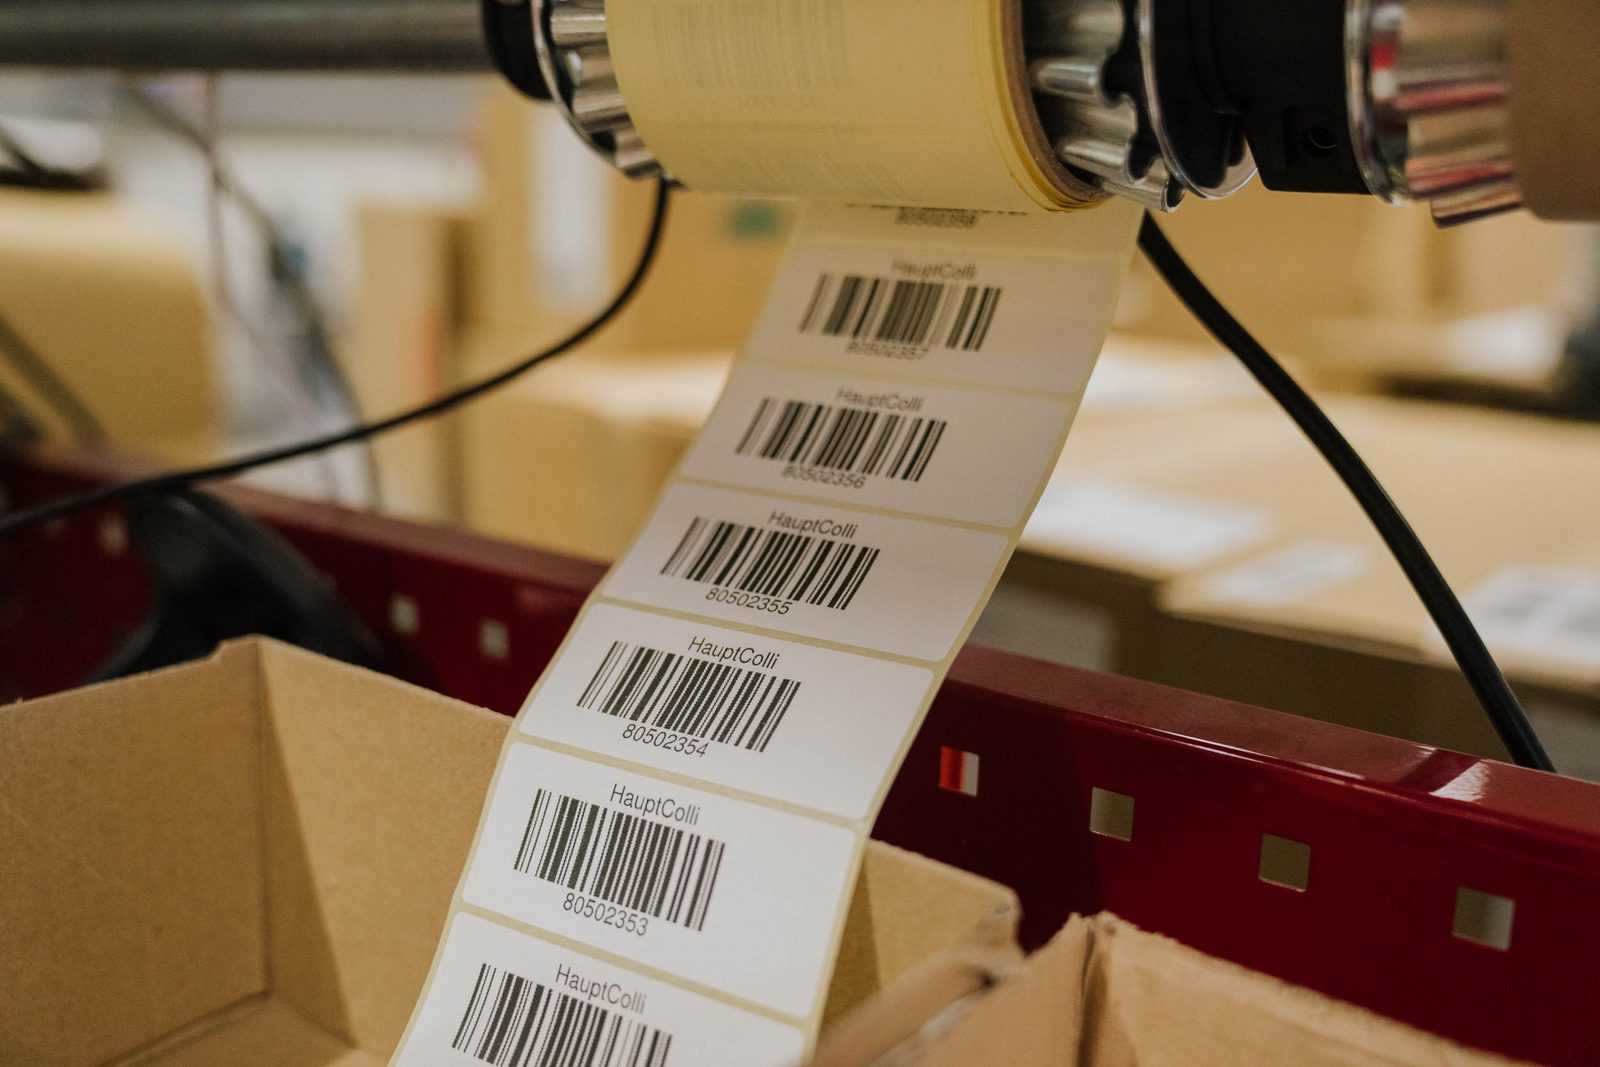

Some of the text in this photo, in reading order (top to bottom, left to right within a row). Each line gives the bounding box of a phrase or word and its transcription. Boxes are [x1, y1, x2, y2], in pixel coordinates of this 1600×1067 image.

[836, 387, 924, 412] HauptColli
[781, 465, 867, 489] 80502356
[768, 511, 859, 539] HauptColli
[705, 587, 793, 615] 80502355
[688, 636, 780, 669] HauptColli
[622, 723, 709, 758] 80502354
[610, 783, 701, 826] HauptColli
[563, 893, 649, 936] 80502353
[555, 963, 647, 1014] HauptColli
